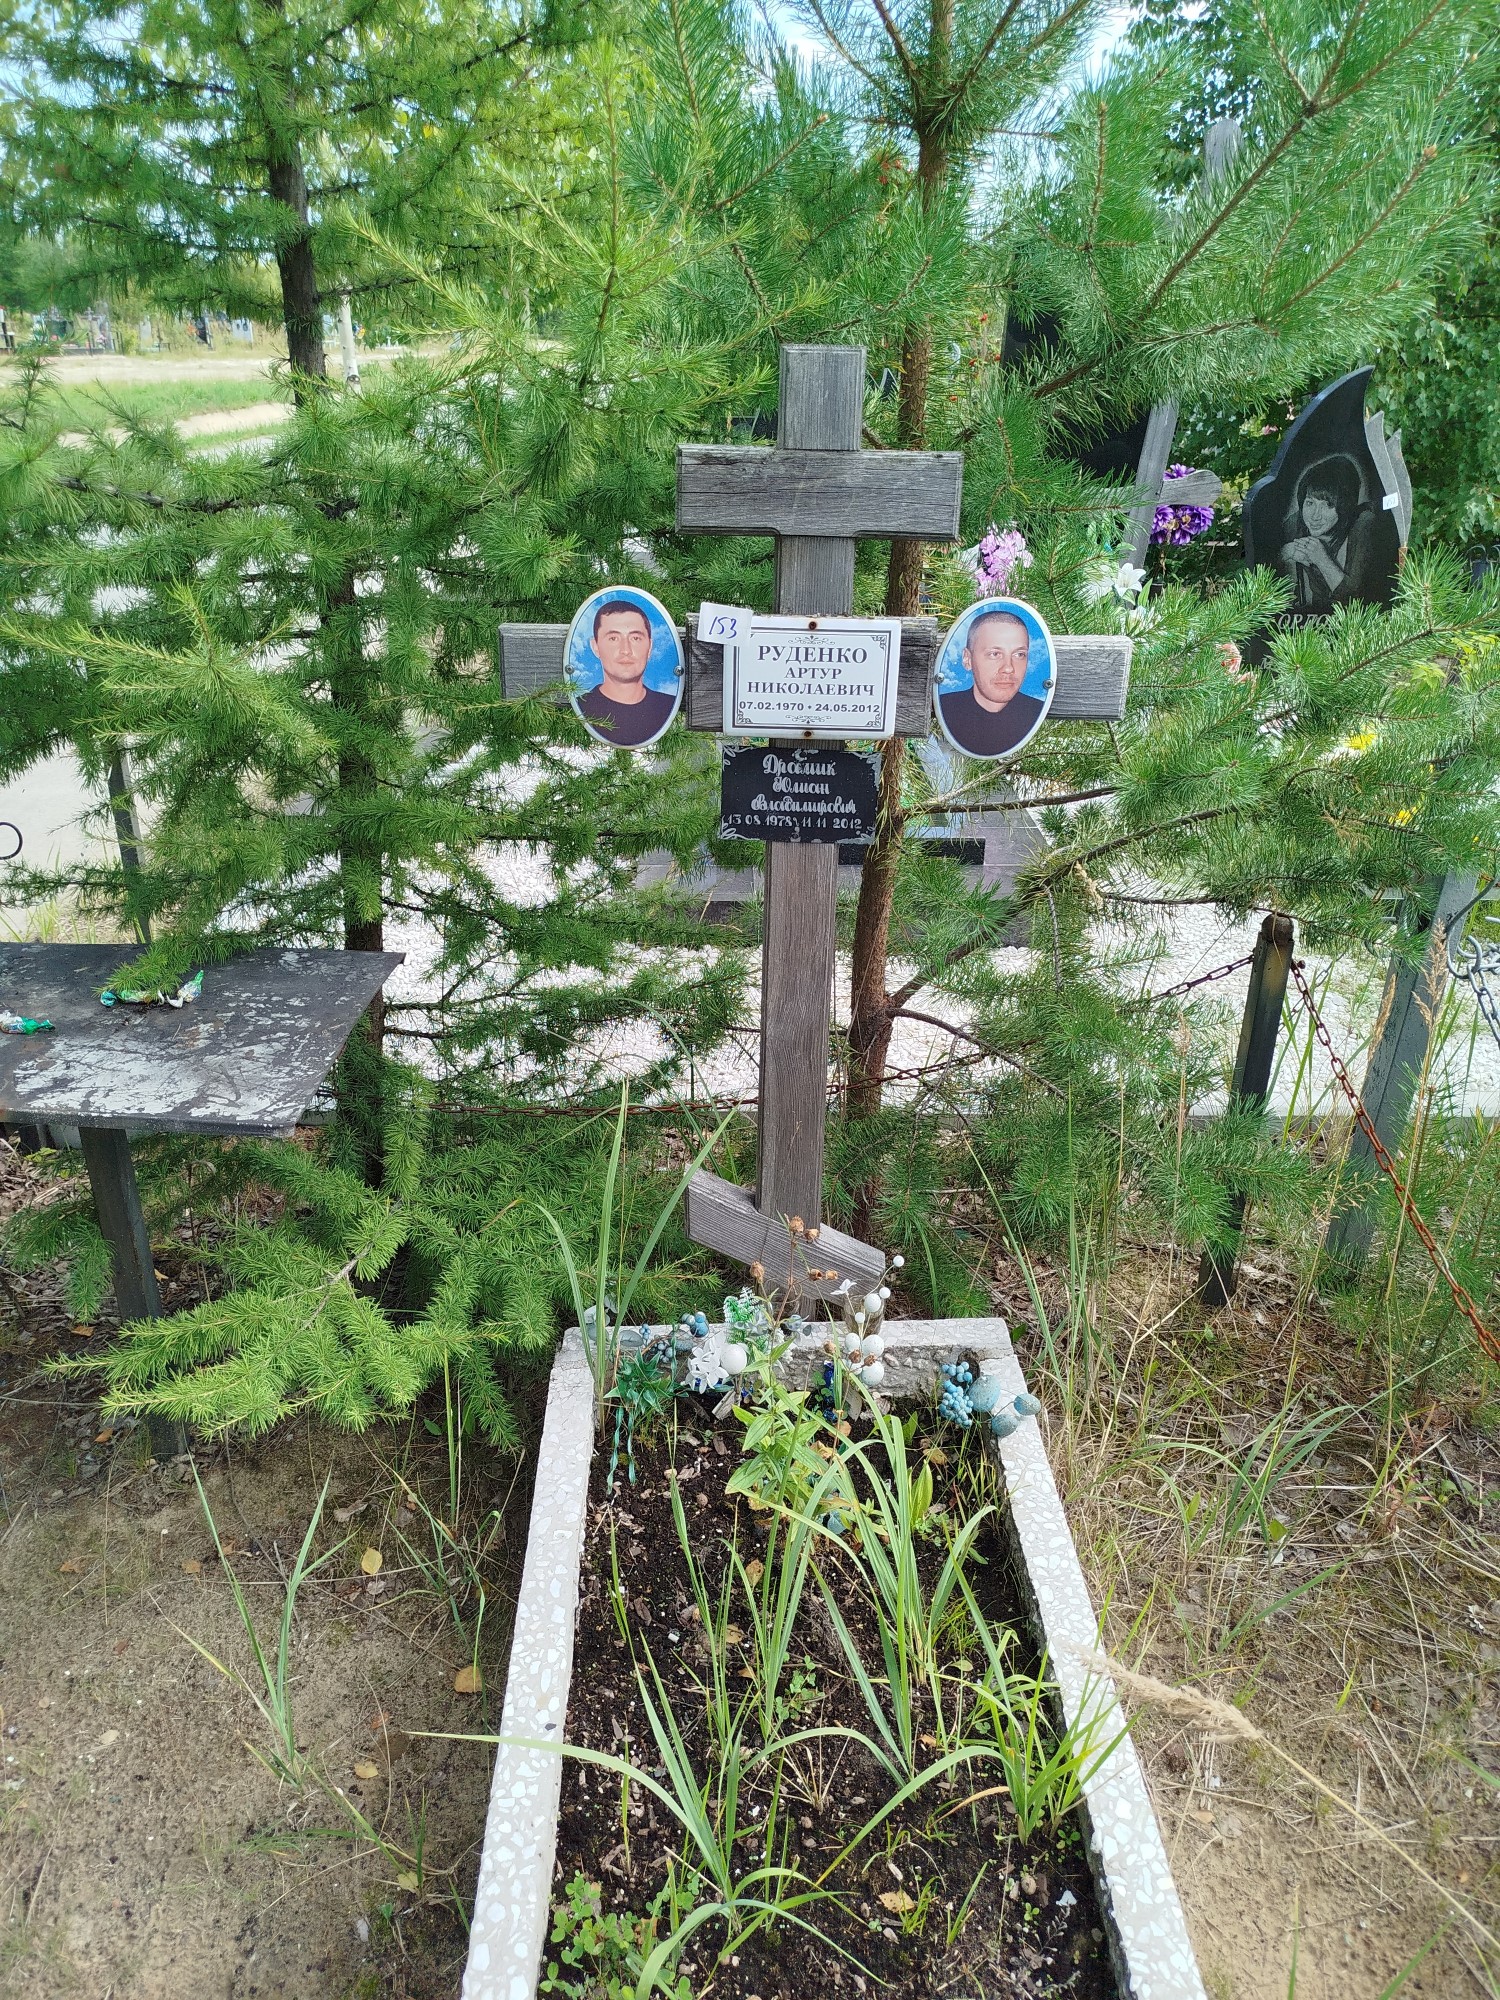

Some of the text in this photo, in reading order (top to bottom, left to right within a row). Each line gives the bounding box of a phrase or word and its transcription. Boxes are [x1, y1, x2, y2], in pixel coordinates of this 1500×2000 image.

[708, 615, 738, 639] 153
[757, 645, 868, 664] РУДЕНКО
[784, 667, 842, 680] АРТУР
[747, 681, 875, 696] НИКОЛАЕВИЧ
[739, 700, 880, 713] 07.02.1970 24.05.2012
[772, 776, 830, 795] Юлиан
[750, 794, 857, 816] Владимирович
